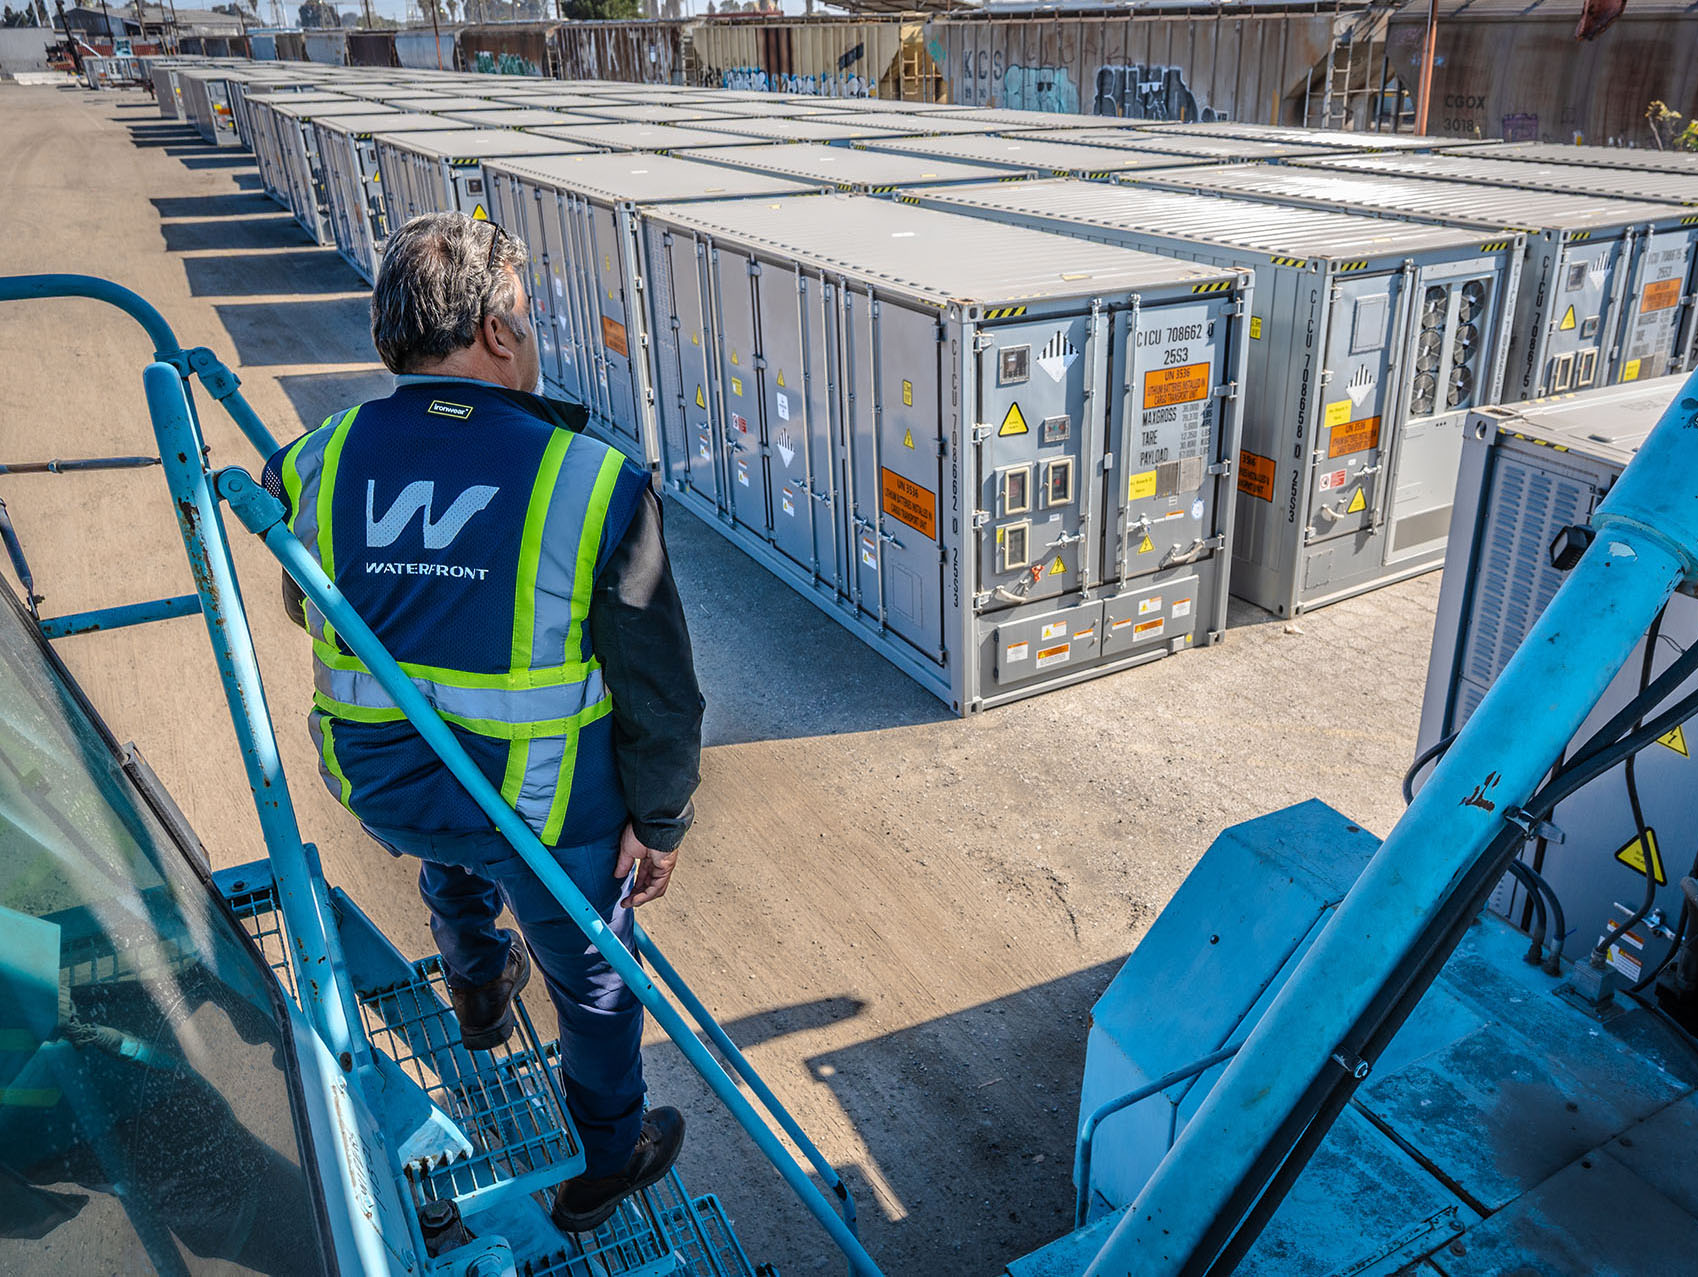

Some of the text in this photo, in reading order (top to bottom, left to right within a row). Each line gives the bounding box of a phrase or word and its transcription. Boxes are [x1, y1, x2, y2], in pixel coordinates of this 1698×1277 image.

[964, 49, 1002, 80] KCS
[1536, 255, 1550, 308] CICU
[1305, 289, 1317, 349] CICU
[1136, 328, 1162, 348] CICU
[1167, 322, 1202, 342] 708662
[1163, 347, 1189, 366] 25S3
[1164, 368, 1190, 380] UN 3536
[1296, 354, 1312, 440] 708658
[1142, 406, 1177, 426] MAXGROSS
[1142, 430, 1158, 447] TARE
[1140, 448, 1168, 466] PAYLOAD
[1288, 471, 1300, 523] 25S3
[366, 562, 490, 581] WATERFRONT
